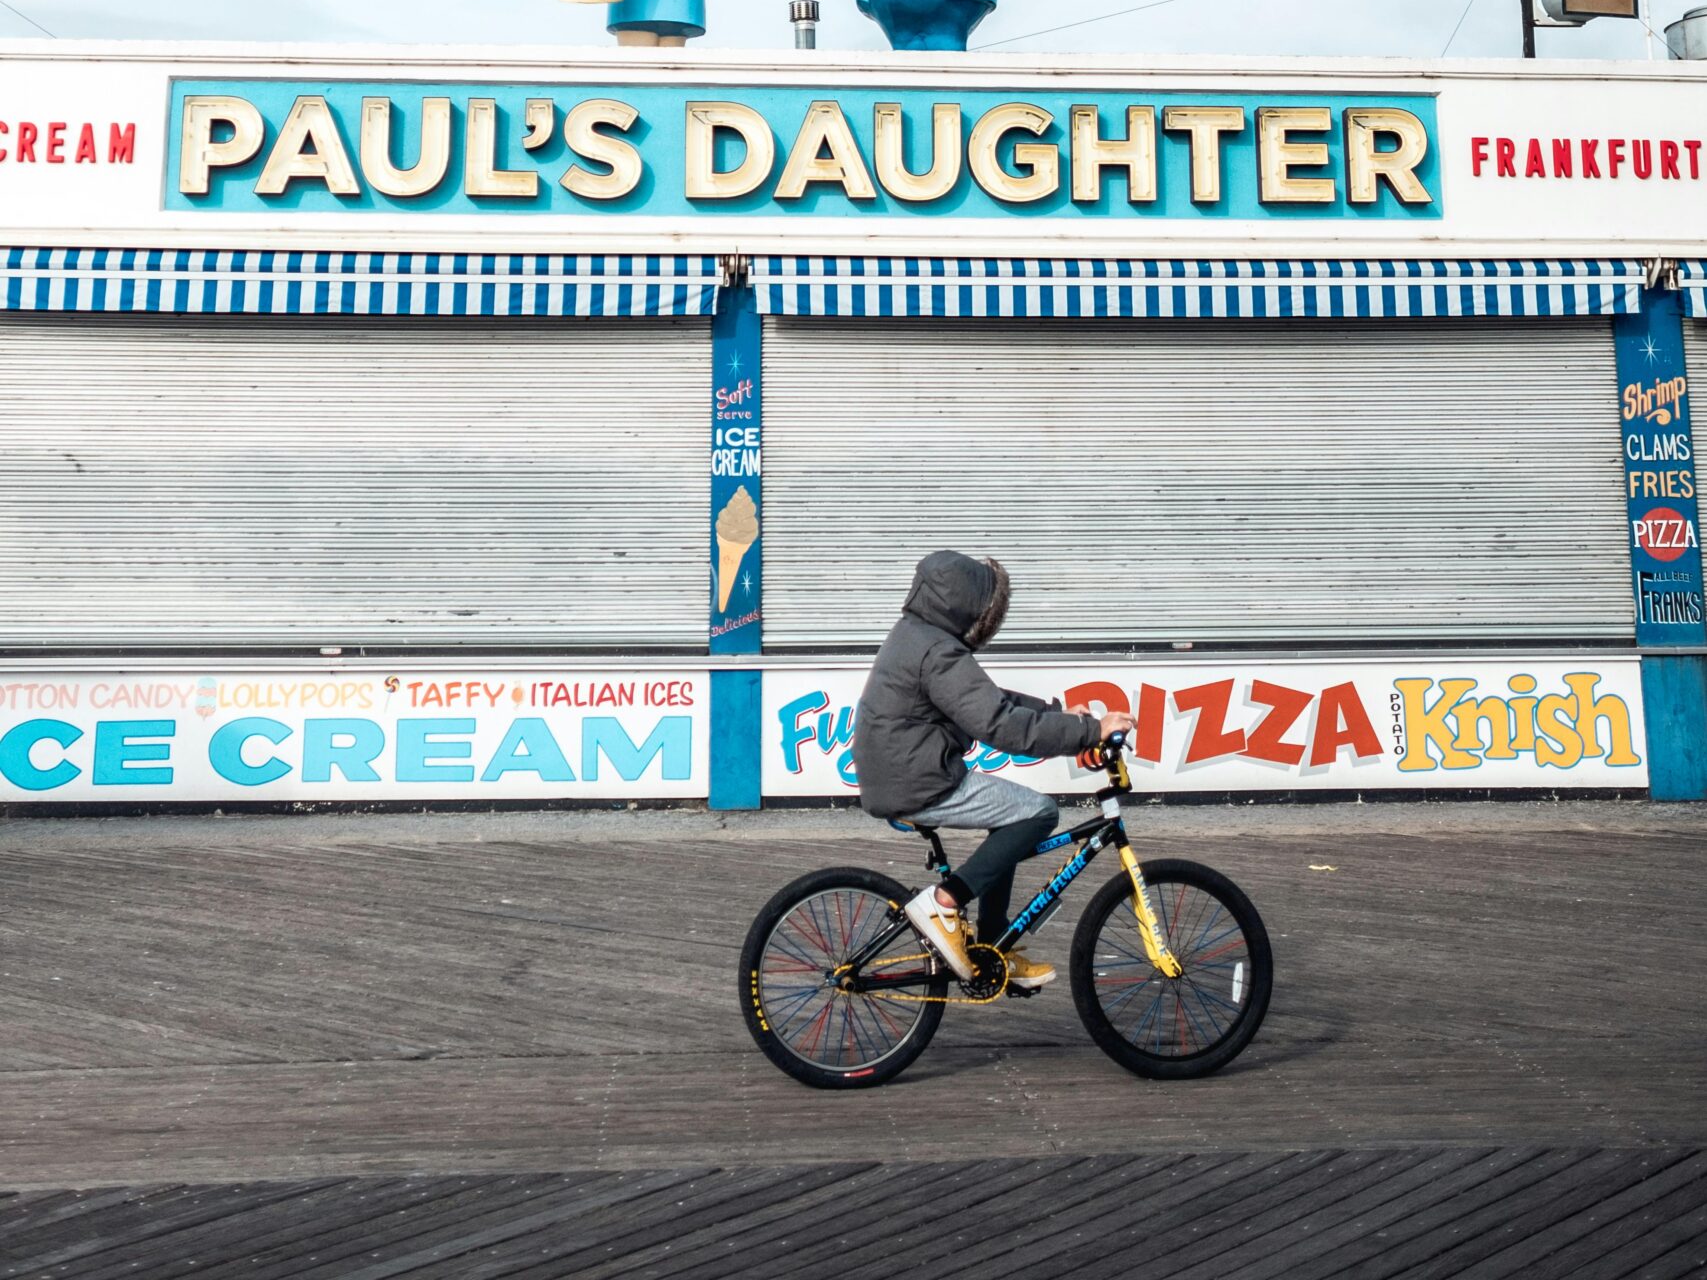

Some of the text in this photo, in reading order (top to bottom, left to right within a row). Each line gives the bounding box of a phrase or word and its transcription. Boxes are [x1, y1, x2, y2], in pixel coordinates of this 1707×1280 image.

[179, 94, 1434, 206] PAUL'S DAUGHTER
[1471, 136, 1702, 180] FRANKFURT
[715, 378, 753, 410] Soft
[1622, 376, 1687, 421] Shrimp
[716, 410, 753, 420] serve
[716, 427, 760, 447] ICE
[1626, 433, 1691, 461] CLAMS
[712, 448, 761, 477] CREAM
[1629, 470, 1695, 499] FRIES
[1632, 519, 1699, 548] PIZZA
[1637, 570, 1703, 625] FRANKS
[0, 681, 197, 710] TTON CANDY
[218, 682, 375, 709] LOLLYPOPS
[407, 681, 505, 708] TAFFY
[531, 681, 694, 708] ITALIAN ICES
[1390, 693, 1405, 755] POTATO
[1393, 672, 1642, 772] Knish
[208, 715, 692, 787] CREAM
[751, 970, 769, 1032] MAXXIS
